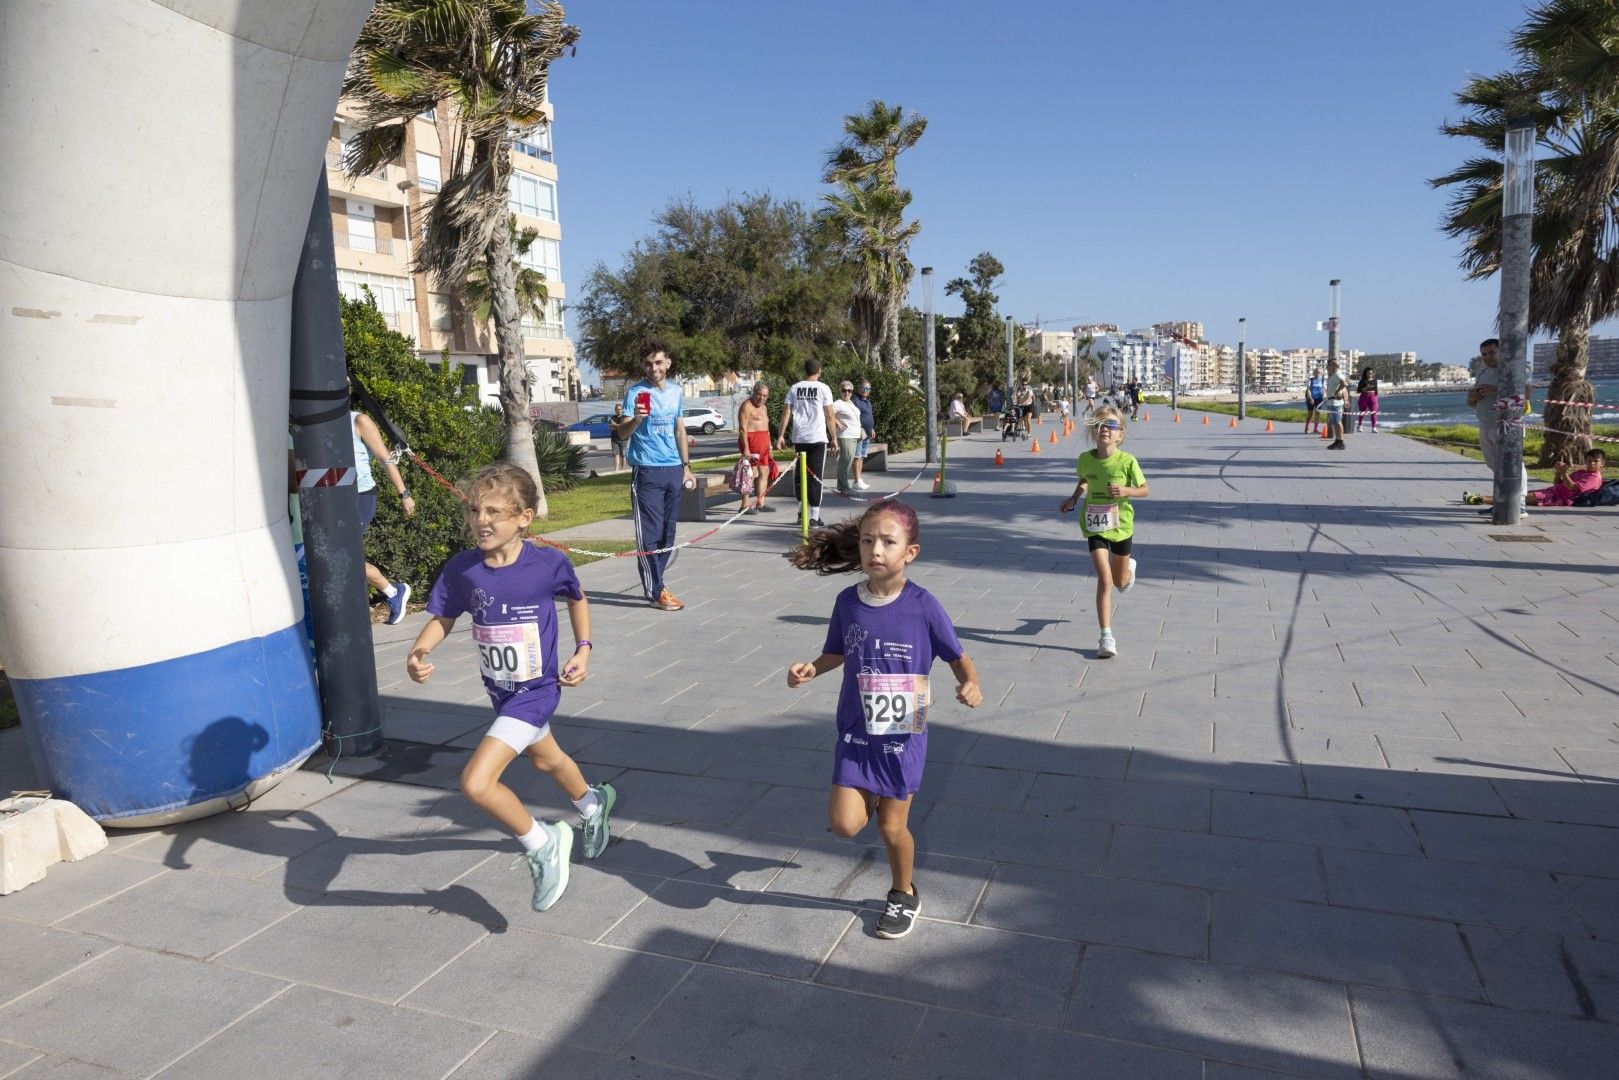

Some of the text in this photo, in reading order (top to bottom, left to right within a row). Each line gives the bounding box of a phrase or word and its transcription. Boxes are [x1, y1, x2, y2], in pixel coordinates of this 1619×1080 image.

[796, 387, 818, 397] MM
[1087, 514, 1109, 527] 544
[478, 644, 518, 672] 500
[863, 694, 907, 723] 529
